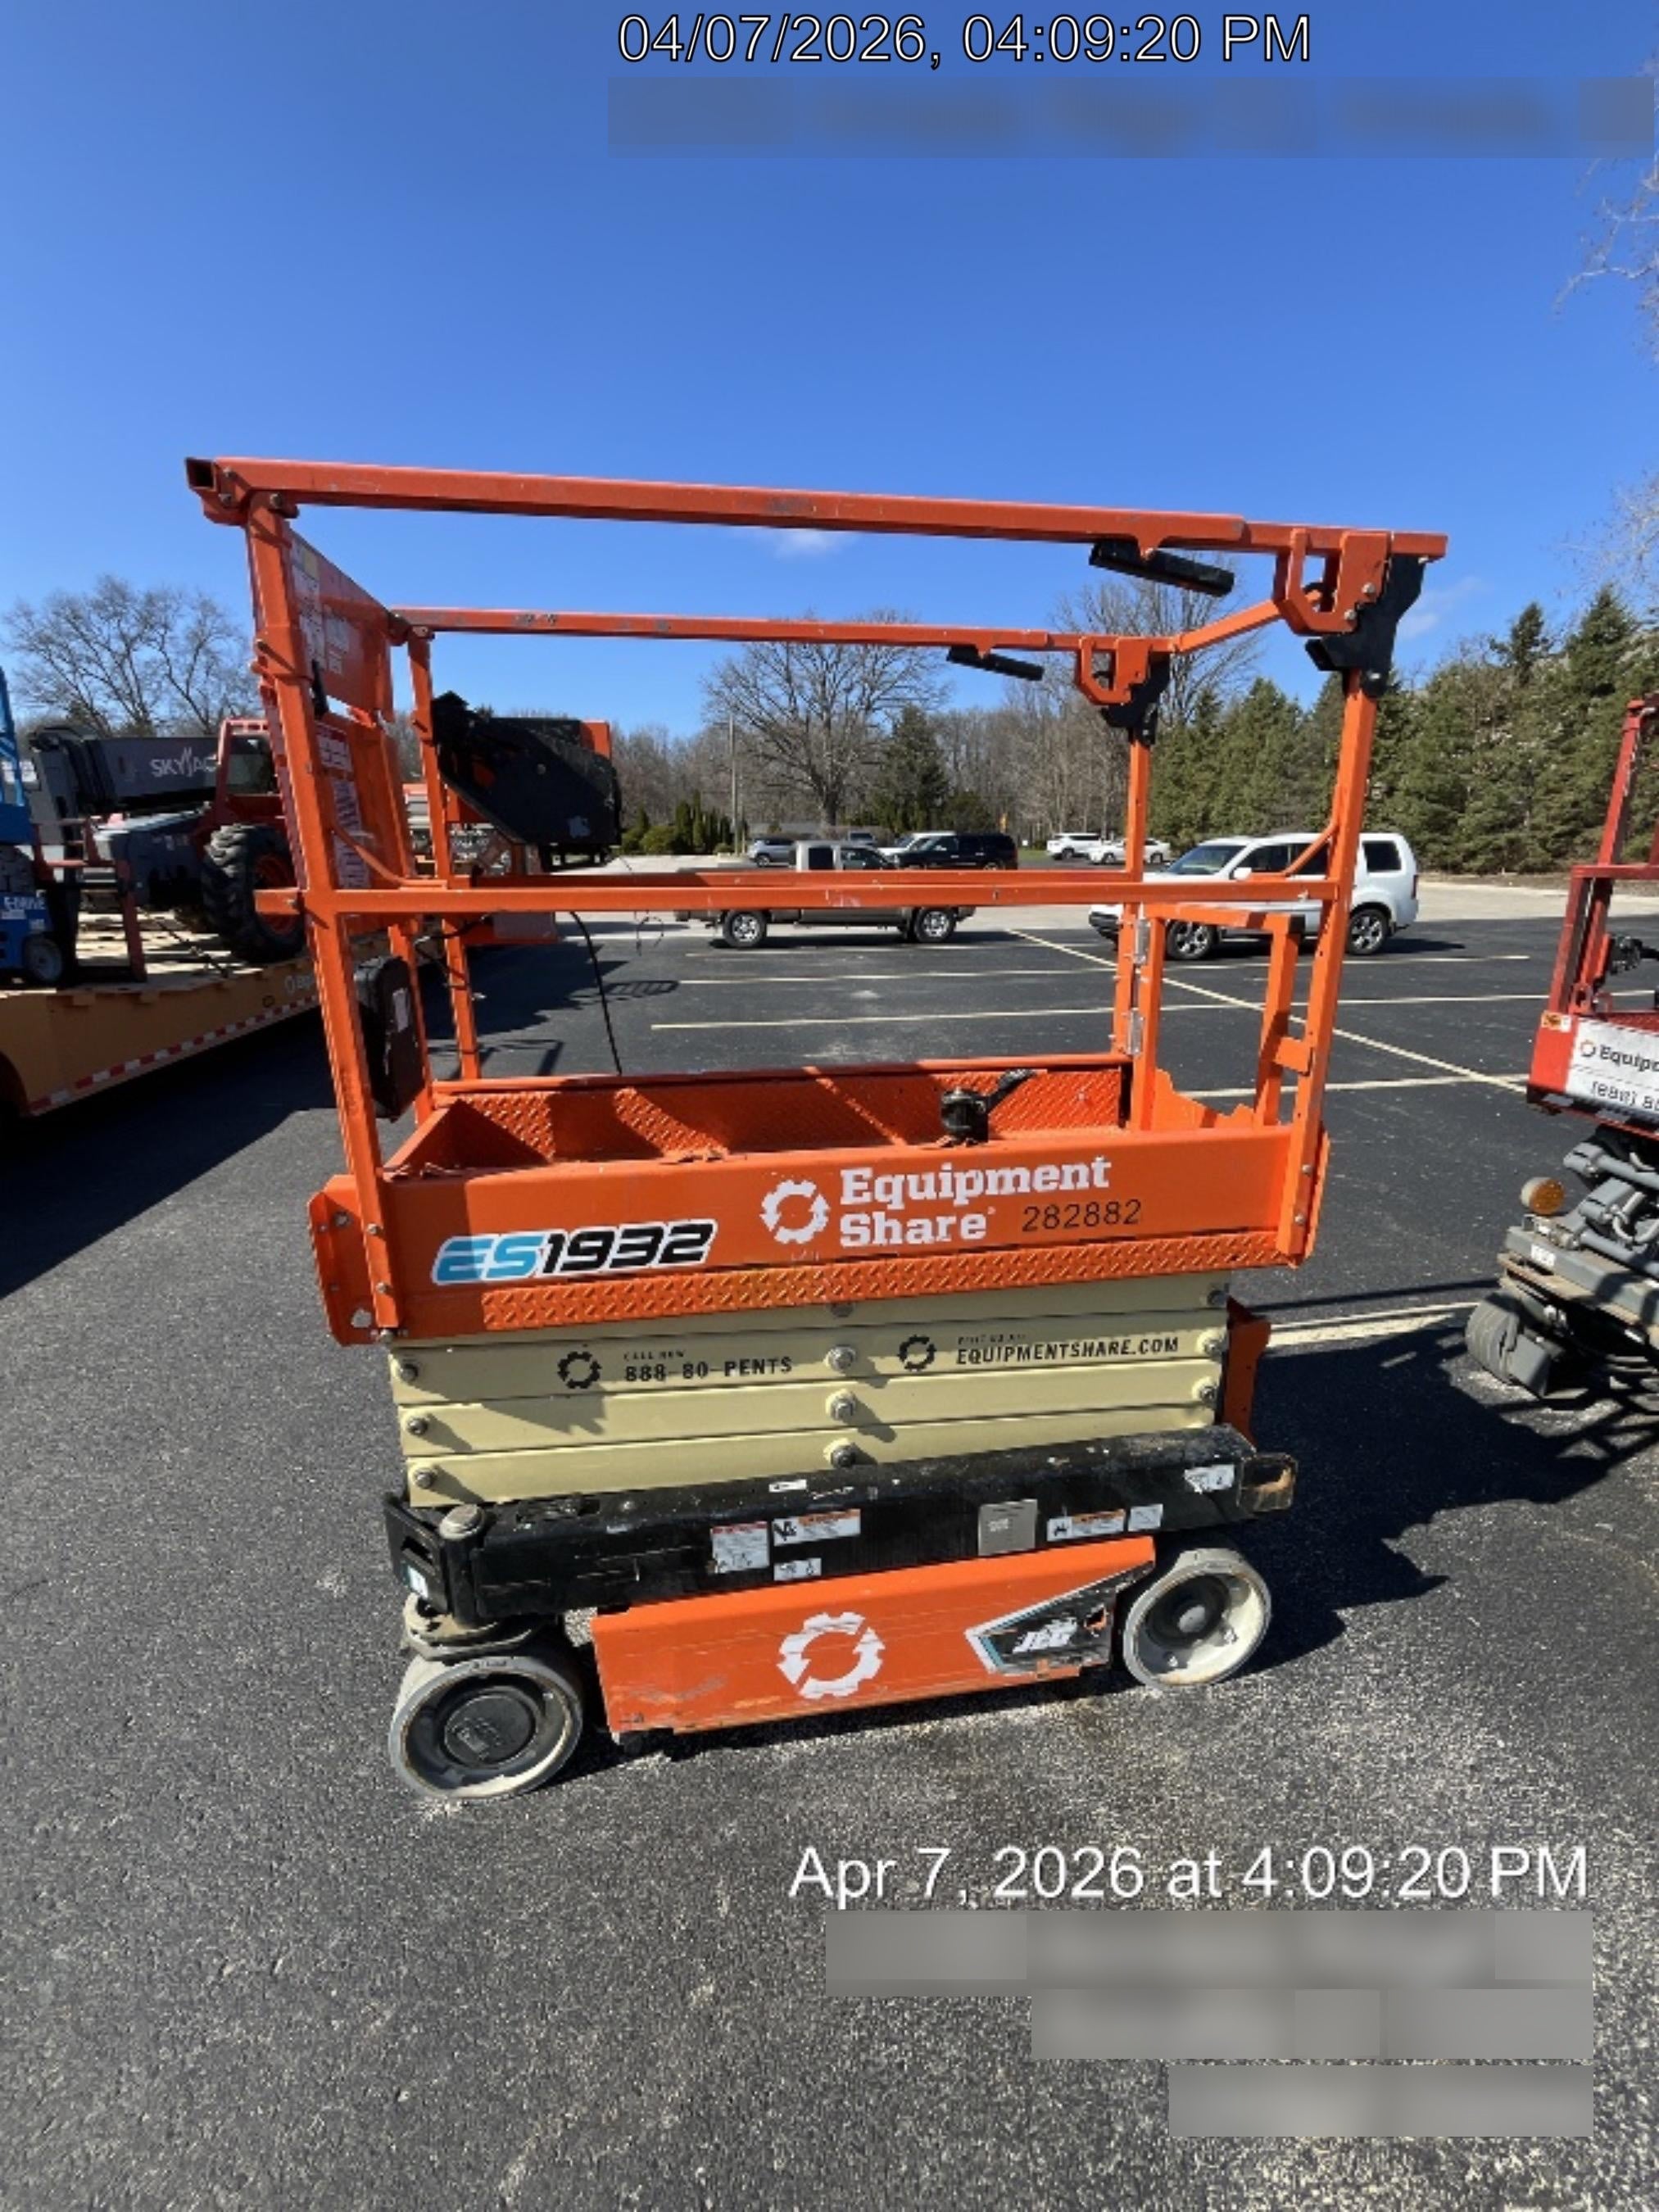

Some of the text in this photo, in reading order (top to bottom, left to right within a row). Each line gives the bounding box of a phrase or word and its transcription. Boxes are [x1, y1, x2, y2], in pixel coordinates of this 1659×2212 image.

[150, 746, 216, 777] SKYJAC
[839, 1156, 1112, 1210] Equipment
[839, 1212, 987, 1248] Share
[1022, 1199, 1142, 1232] 282882
[431, 1218, 718, 1285] ES1932
[956, 1337, 1178, 1365] EQUIPMENTSHARE.COM
